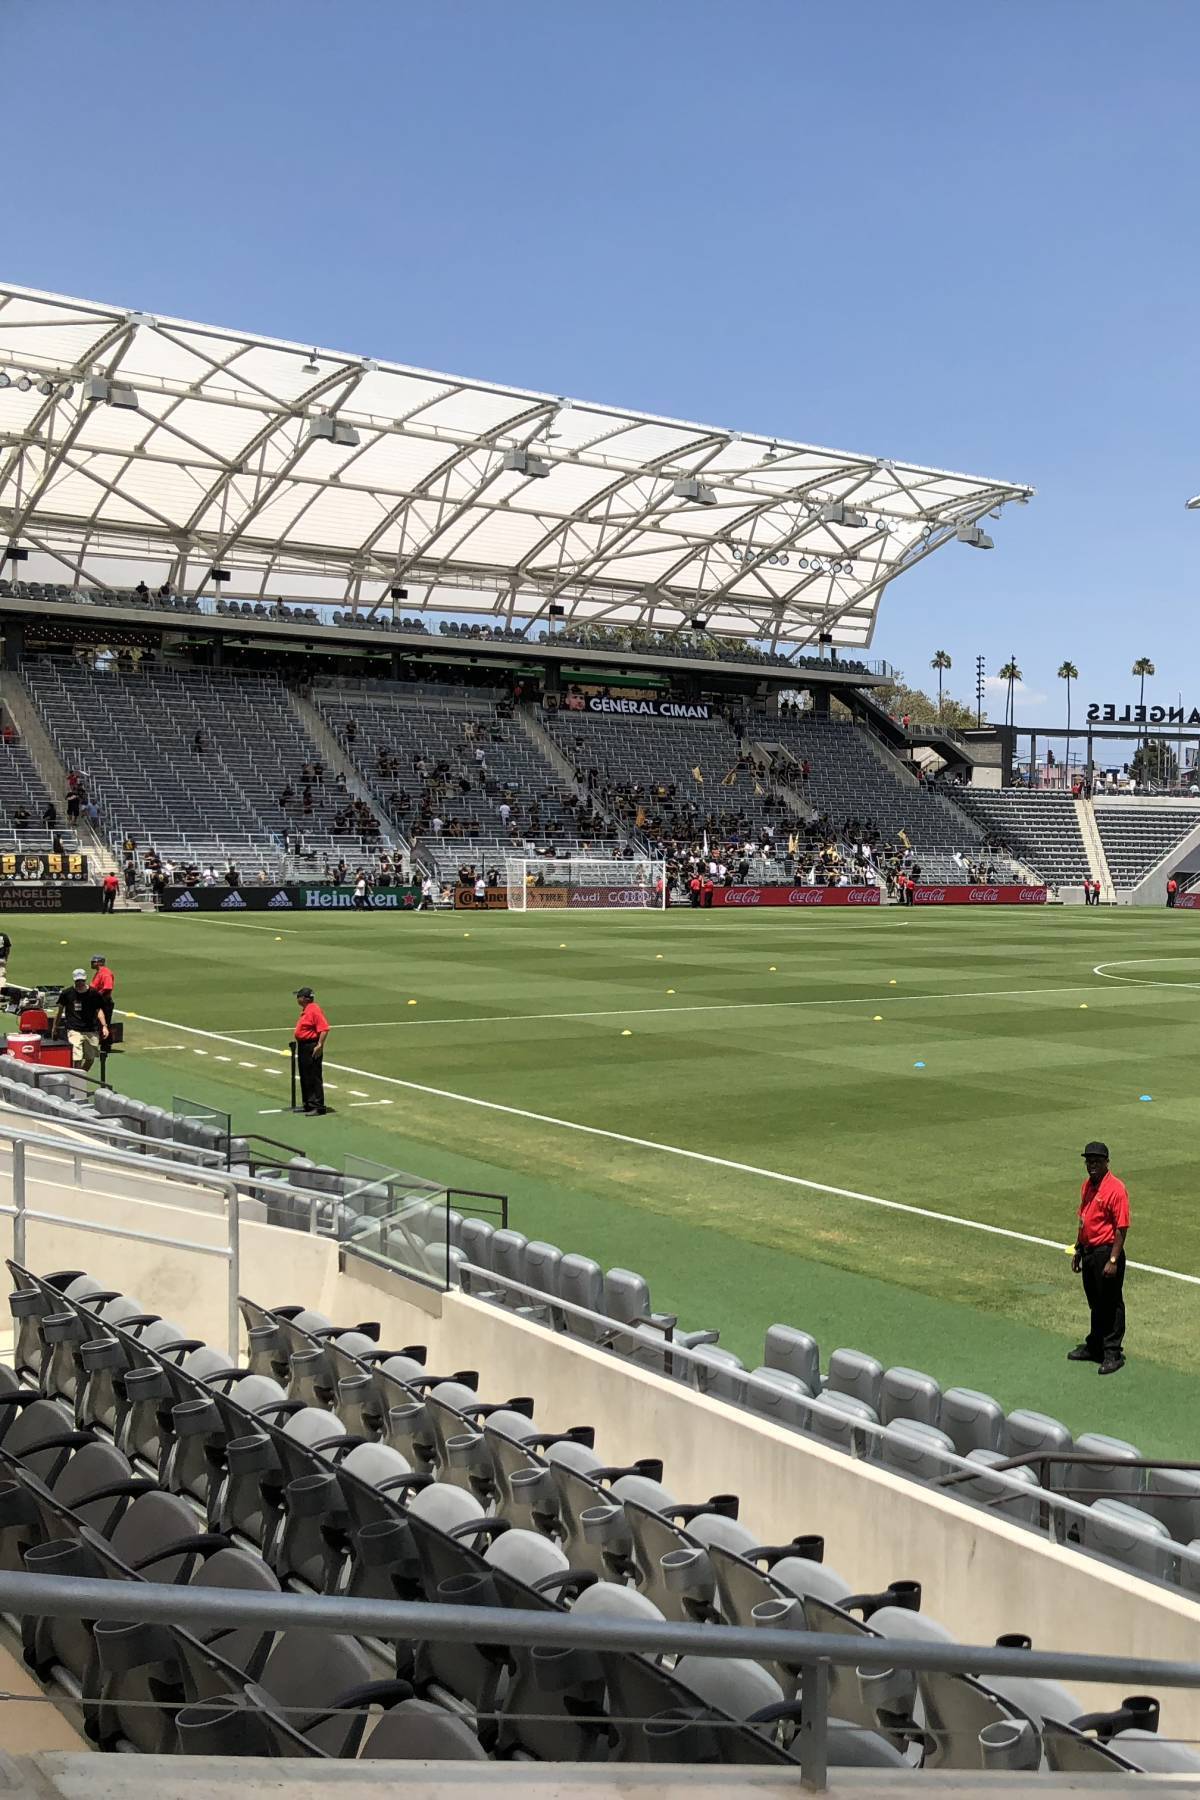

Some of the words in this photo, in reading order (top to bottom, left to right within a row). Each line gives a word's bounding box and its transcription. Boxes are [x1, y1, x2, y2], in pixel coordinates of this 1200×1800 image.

[660, 703, 709, 719] CIMAN
[3, 889, 62, 899] ANGELES
[572, 891, 601, 902] Audi
[724, 888, 761, 904] Coca-Cola
[788, 888, 825, 903] Coca-Cola
[914, 888, 946, 901] Coca-Cola
[33, 900, 62, 908] CLUB
